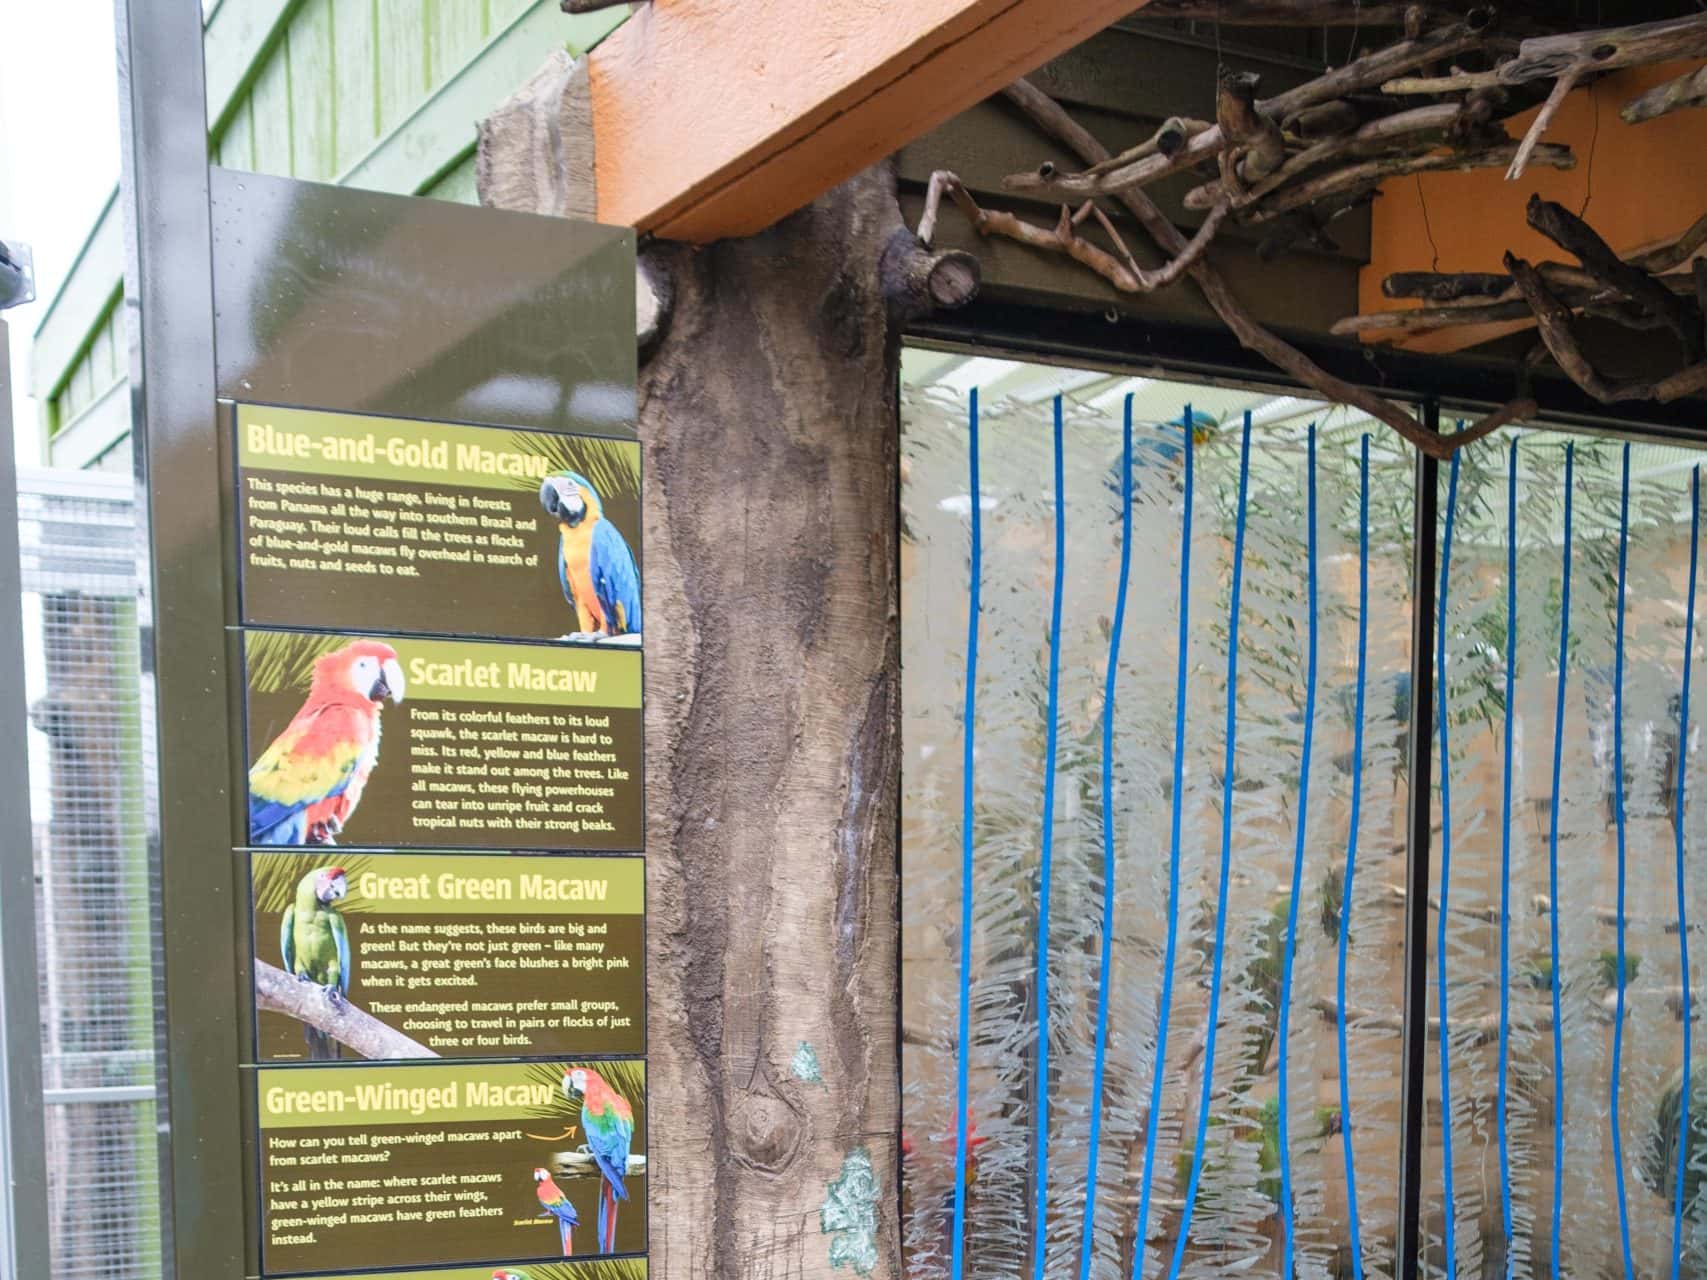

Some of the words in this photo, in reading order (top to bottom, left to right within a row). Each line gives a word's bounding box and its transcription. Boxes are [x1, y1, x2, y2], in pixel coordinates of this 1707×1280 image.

[247, 424, 448, 469] Blue-and-Gold
[457, 444, 548, 479] Macaw
[247, 477, 274, 492] This
[275, 482, 318, 496] species
[320, 483, 342, 498] has
[344, 489, 353, 498] a
[355, 486, 384, 503] huge
[386, 492, 422, 506] range,
[425, 492, 456, 510] living
[458, 495, 470, 507] in
[472, 496, 511, 511] forests
[248, 496, 278, 510] from
[281, 499, 328, 515] Panama
[330, 504, 346, 516] all
[348, 505, 370, 518] the
[372, 509, 397, 522] way
[399, 508, 424, 522] into
[426, 512, 478, 526] southern
[481, 515, 513, 529] Brazil
[515, 519, 536, 531] and
[250, 553, 287, 569] fruits,
[289, 558, 317, 569] nuts
[319, 559, 342, 571] and
[345, 561, 377, 573] seeds
[379, 564, 394, 574] to
[396, 566, 420, 576] eat.
[410, 658, 500, 688] Scarlet
[508, 663, 596, 692] Macaw
[411, 708, 439, 720] From
[442, 709, 457, 721] its
[459, 710, 503, 723] colorful
[505, 712, 550, 725] feathers
[553, 716, 566, 726] to
[569, 714, 583, 726] its
[585, 715, 609, 727] loud
[411, 762, 441, 774] make
[444, 763, 454, 775] it
[456, 764, 488, 775] stand
[490, 766, 511, 776] out
[513, 768, 550, 780] among
[552, 766, 571, 778] the
[574, 768, 604, 779] trees.
[608, 768, 629, 780] Like
[412, 816, 456, 830] tropical
[459, 818, 484, 828] nuts
[486, 817, 512, 828] with
[515, 817, 542, 829] their
[544, 820, 580, 832] strong
[582, 819, 615, 831] beaks.
[360, 872, 430, 899] Great
[438, 874, 511, 899] Green
[520, 875, 607, 900] Macaw
[360, 922, 375, 934] As
[377, 922, 398, 934] the
[401, 925, 431, 934] name
[434, 924, 483, 937] suggests,
[486, 922, 516, 934] these
[519, 922, 546, 934] birds
[548, 925, 565, 934] are
[568, 923, 585, 936] big
[587, 923, 607, 934] and
[369, 1002, 402, 1013] These
[405, 1000, 468, 1015] endangered
[472, 1003, 514, 1011] macaws
[516, 1000, 548, 1014] prefer
[551, 999, 578, 1010] small
[581, 1001, 619, 1013] groups,
[429, 1035, 459, 1046] three
[462, 1038, 474, 1046] or
[477, 1034, 500, 1046] four
[503, 1034, 532, 1045] birds.
[267, 1082, 457, 1115] Green-Winged
[466, 1082, 554, 1107] Macaw
[269, 1137, 297, 1148] How
[299, 1139, 320, 1147] can
[323, 1138, 345, 1149] you
[348, 1134, 368, 1145] tell
[371, 1131, 444, 1147] green-winged
[448, 1132, 490, 1141] macaws
[492, 1130, 522, 1142] apart
[270, 1155, 297, 1166] from
[300, 1153, 338, 1165] scarlet
[341, 1150, 390, 1163] macaws?
[271, 1181, 289, 1192] It's
[292, 1180, 306, 1192] all
[310, 1179, 321, 1190] in
[324, 1179, 344, 1190] the
[347, 1180, 380, 1189] name:
[383, 1176, 418, 1187] where
[420, 1174, 457, 1186] scarlet
[460, 1174, 502, 1183] macaws
[270, 1199, 298, 1210] have
[301, 1200, 309, 1208] a
[311, 1196, 349, 1211] yellow
[352, 1194, 384, 1208] stripe
[387, 1195, 422, 1204] across
[424, 1191, 452, 1202] their
[454, 1191, 488, 1203] wings,
[271, 1213, 347, 1231] green-winged
[350, 1213, 394, 1223] macaws
[396, 1210, 423, 1221] have
[425, 1210, 456, 1222] green
[459, 1206, 503, 1217] feathers
[272, 1232, 317, 1245] instead.
